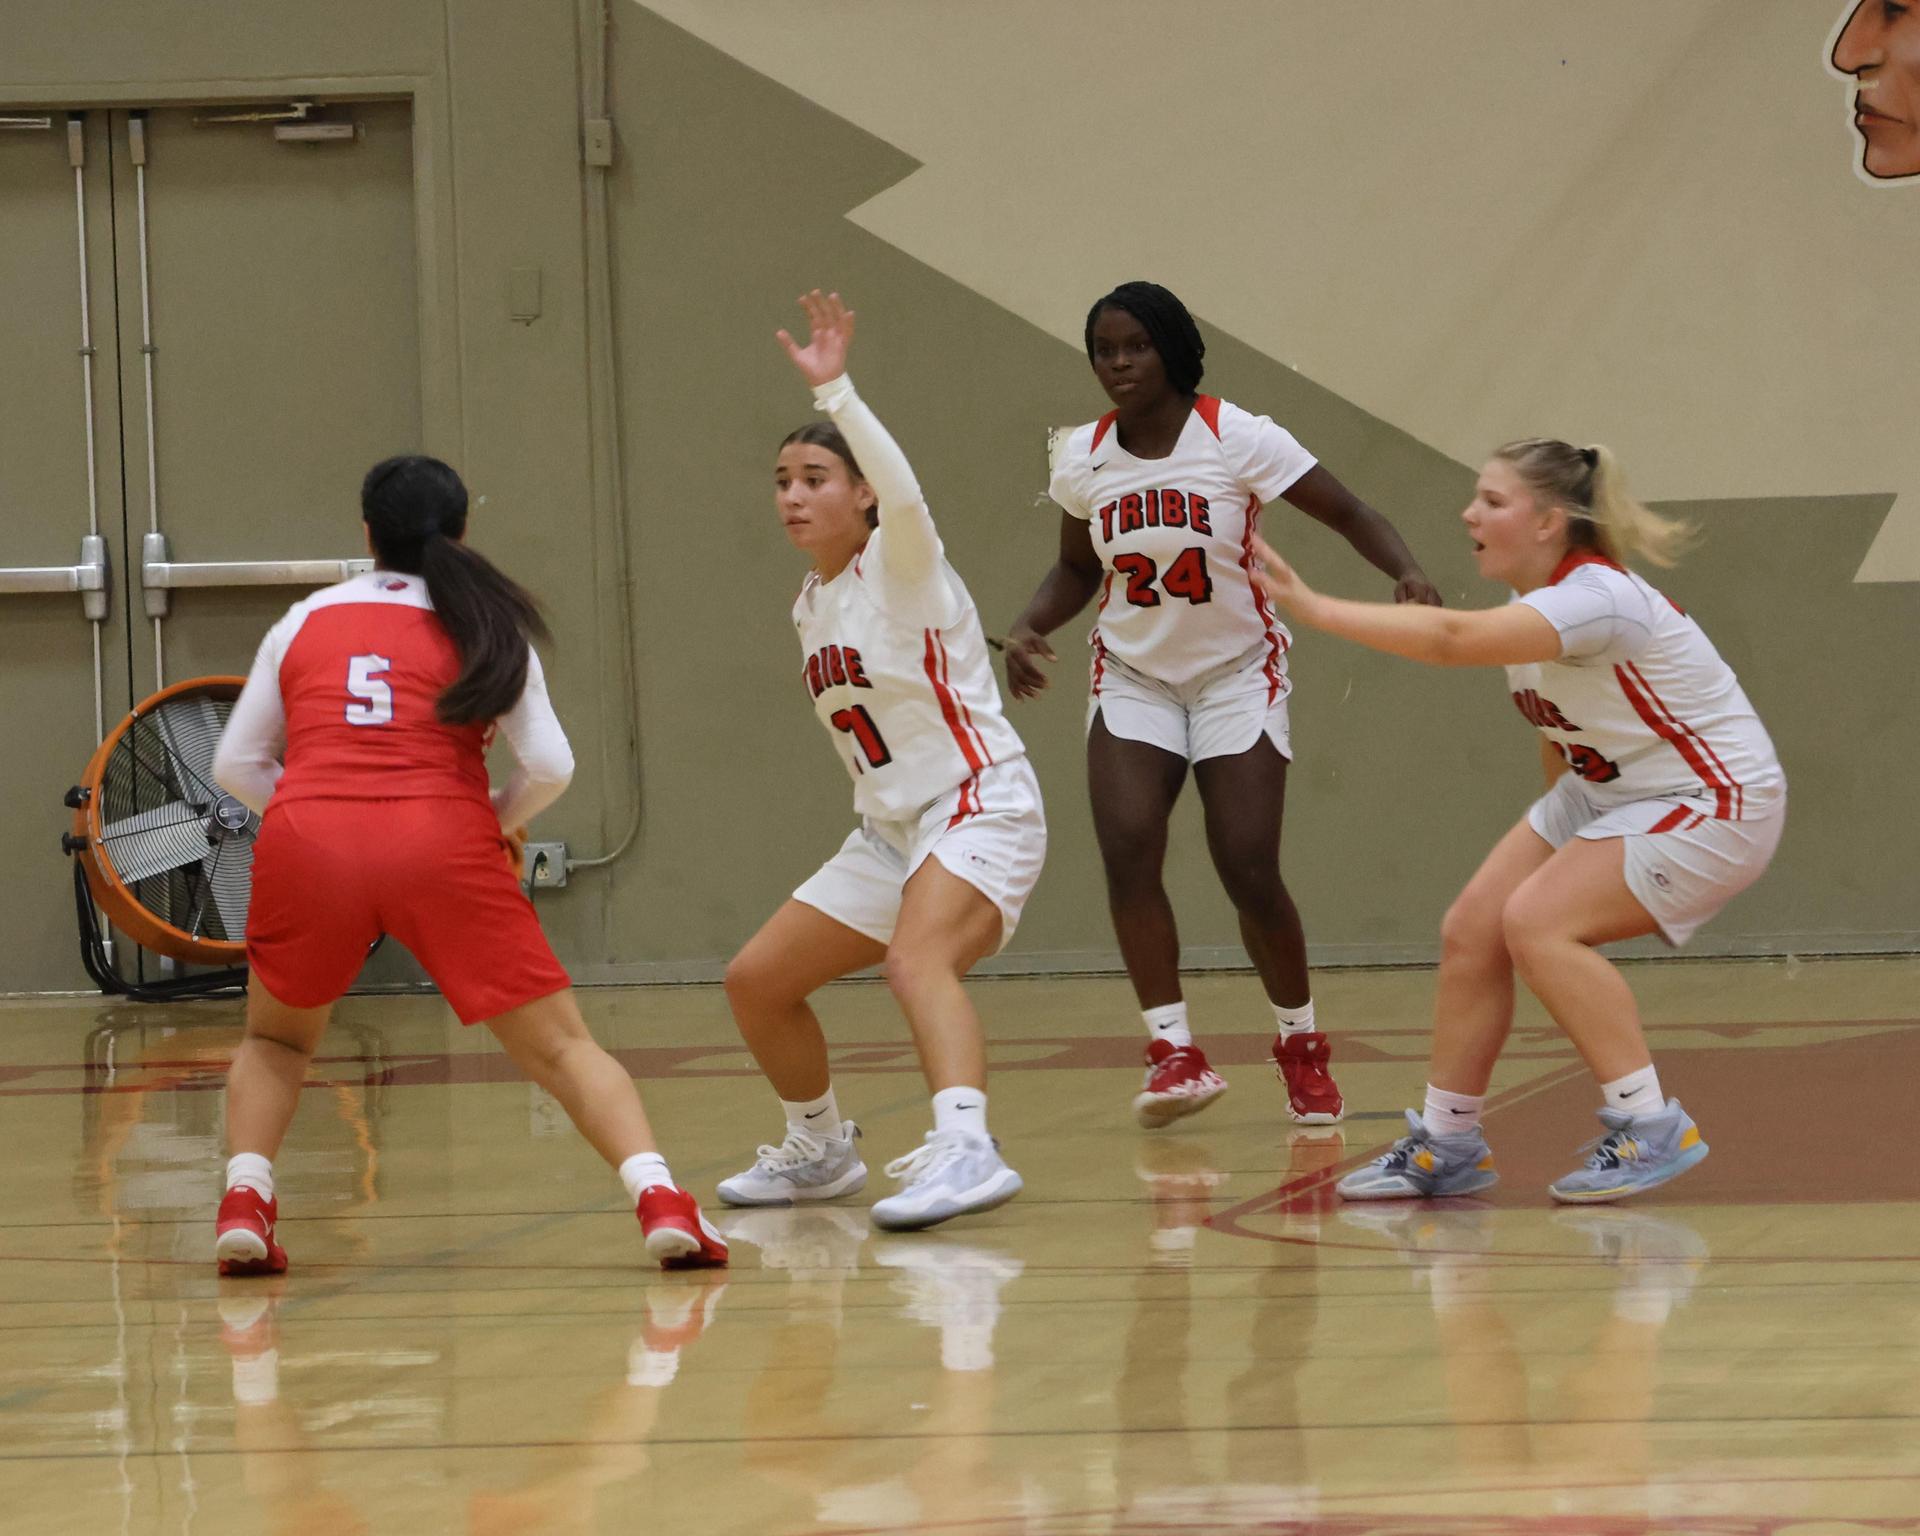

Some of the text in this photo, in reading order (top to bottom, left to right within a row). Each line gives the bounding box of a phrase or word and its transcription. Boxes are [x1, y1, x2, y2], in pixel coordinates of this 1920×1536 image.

[1099, 488, 1213, 544] TRIBE
[1112, 546, 1213, 608] 24
[345, 652, 393, 726] 5
[803, 644, 874, 698] RIBE
